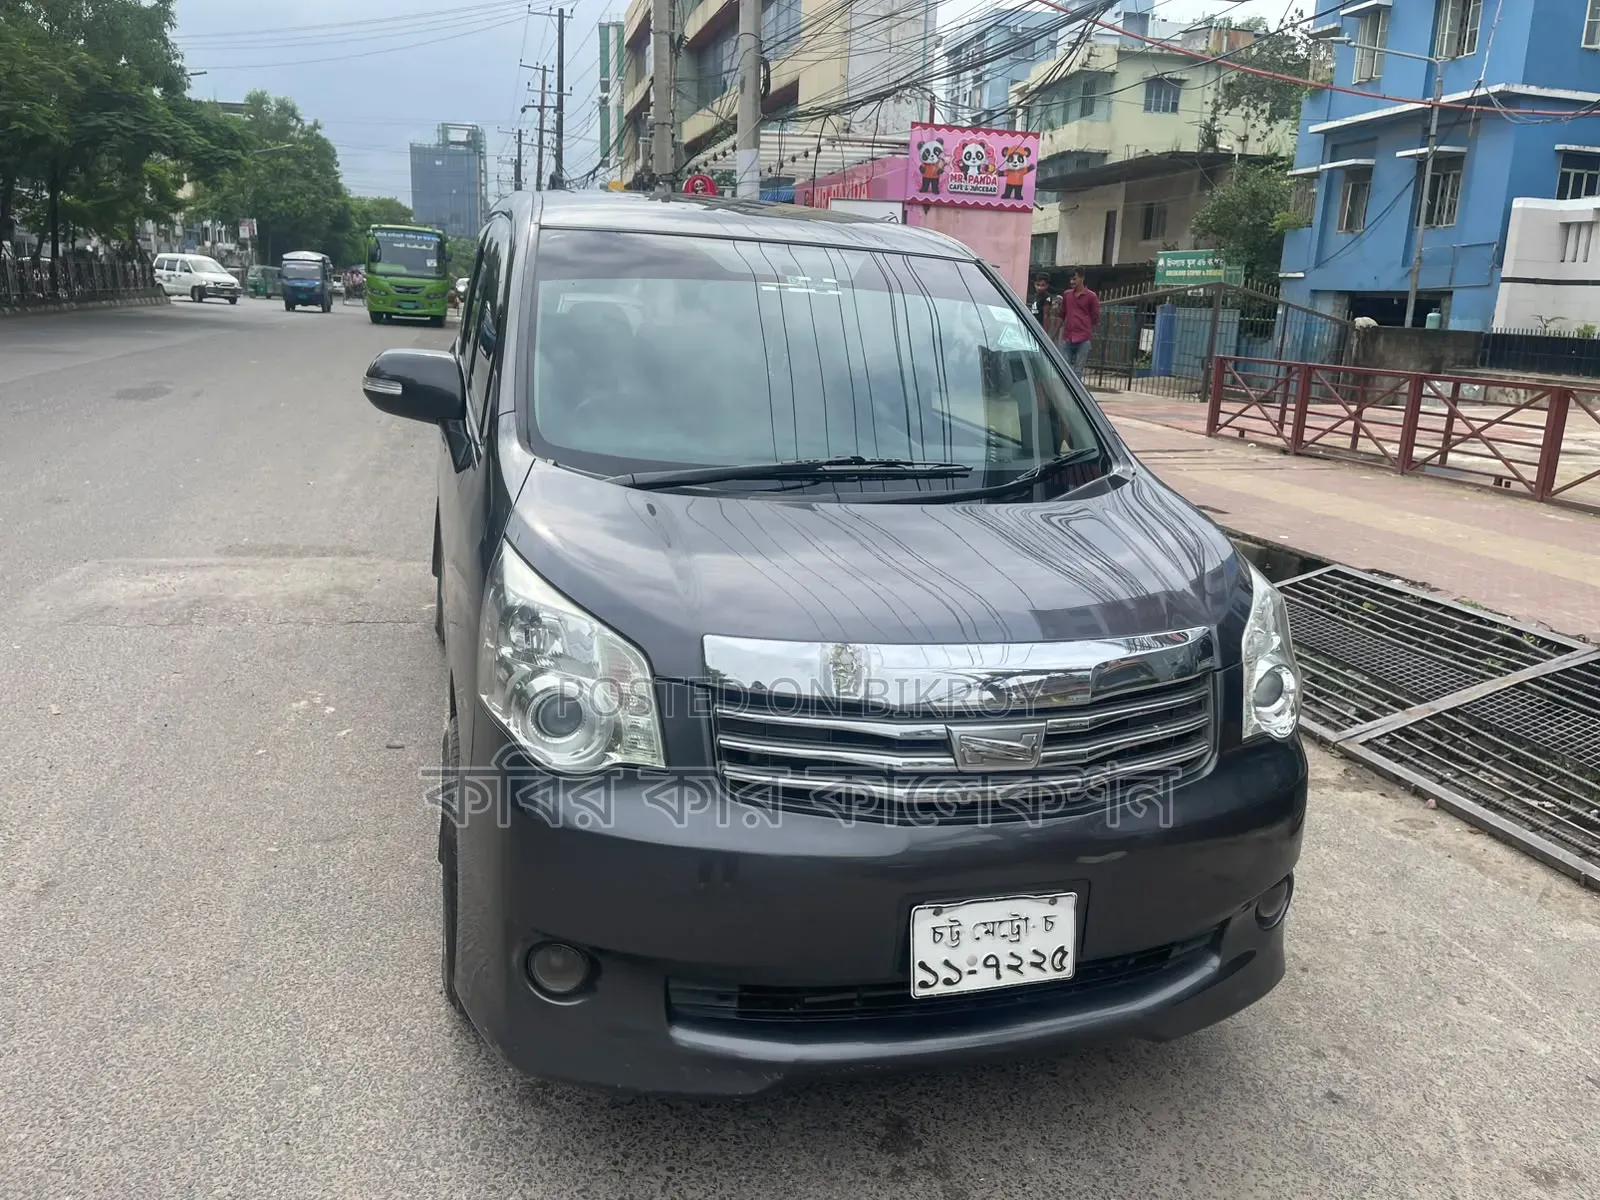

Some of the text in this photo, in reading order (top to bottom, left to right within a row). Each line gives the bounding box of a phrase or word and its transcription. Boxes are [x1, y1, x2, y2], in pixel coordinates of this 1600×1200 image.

[968, 175, 997, 185] PANDA
[932, 919, 962, 948] চট্ট
[918, 946, 1069, 989] ১১-৭২২৫
